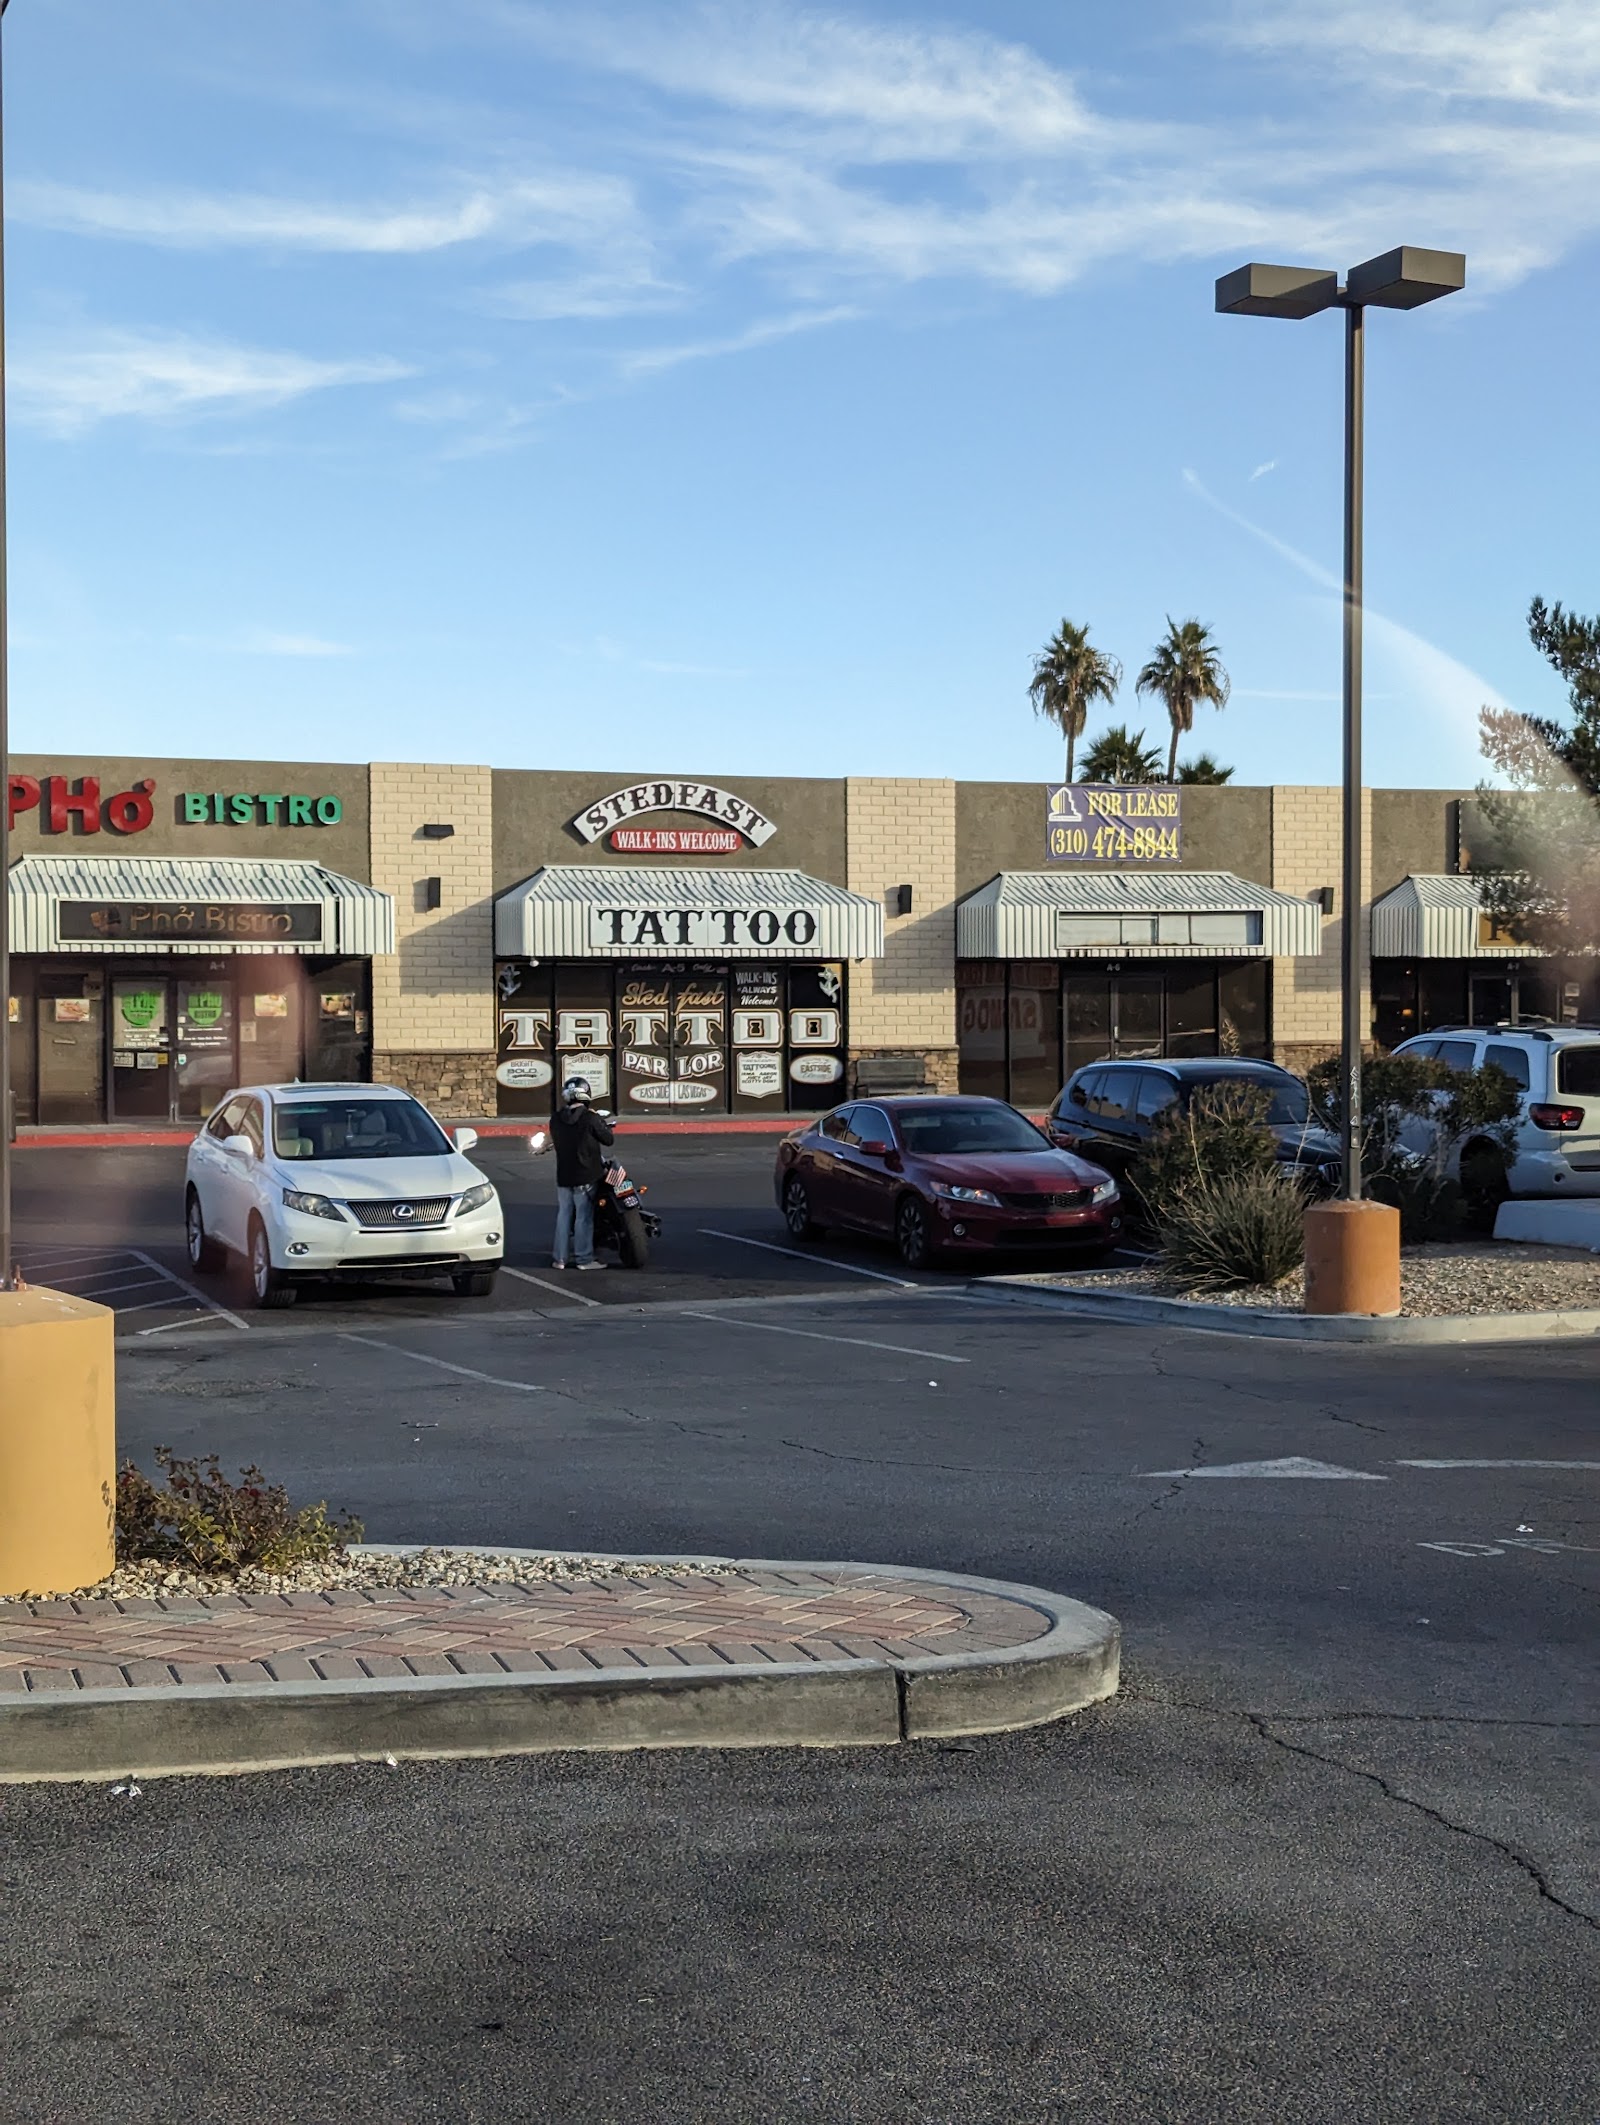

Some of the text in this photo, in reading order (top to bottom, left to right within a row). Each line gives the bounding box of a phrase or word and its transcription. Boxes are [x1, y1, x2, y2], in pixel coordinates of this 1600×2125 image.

[184, 792, 343, 825] BISTRO
[585, 783, 767, 836] STEDFAST
[1088, 791, 1178, 817] FOR LEASE
[679, 832, 738, 850] WELCOME
[1050, 826, 1179, 859] (310) 474-8844
[205, 906, 293, 932] Bistro
[596, 908, 818, 946] TATTOO
[735, 972, 778, 985] WALK-INS
[741, 986, 777, 994] ALWAYS
[800, 1064, 832, 1073] EASTSIDE
